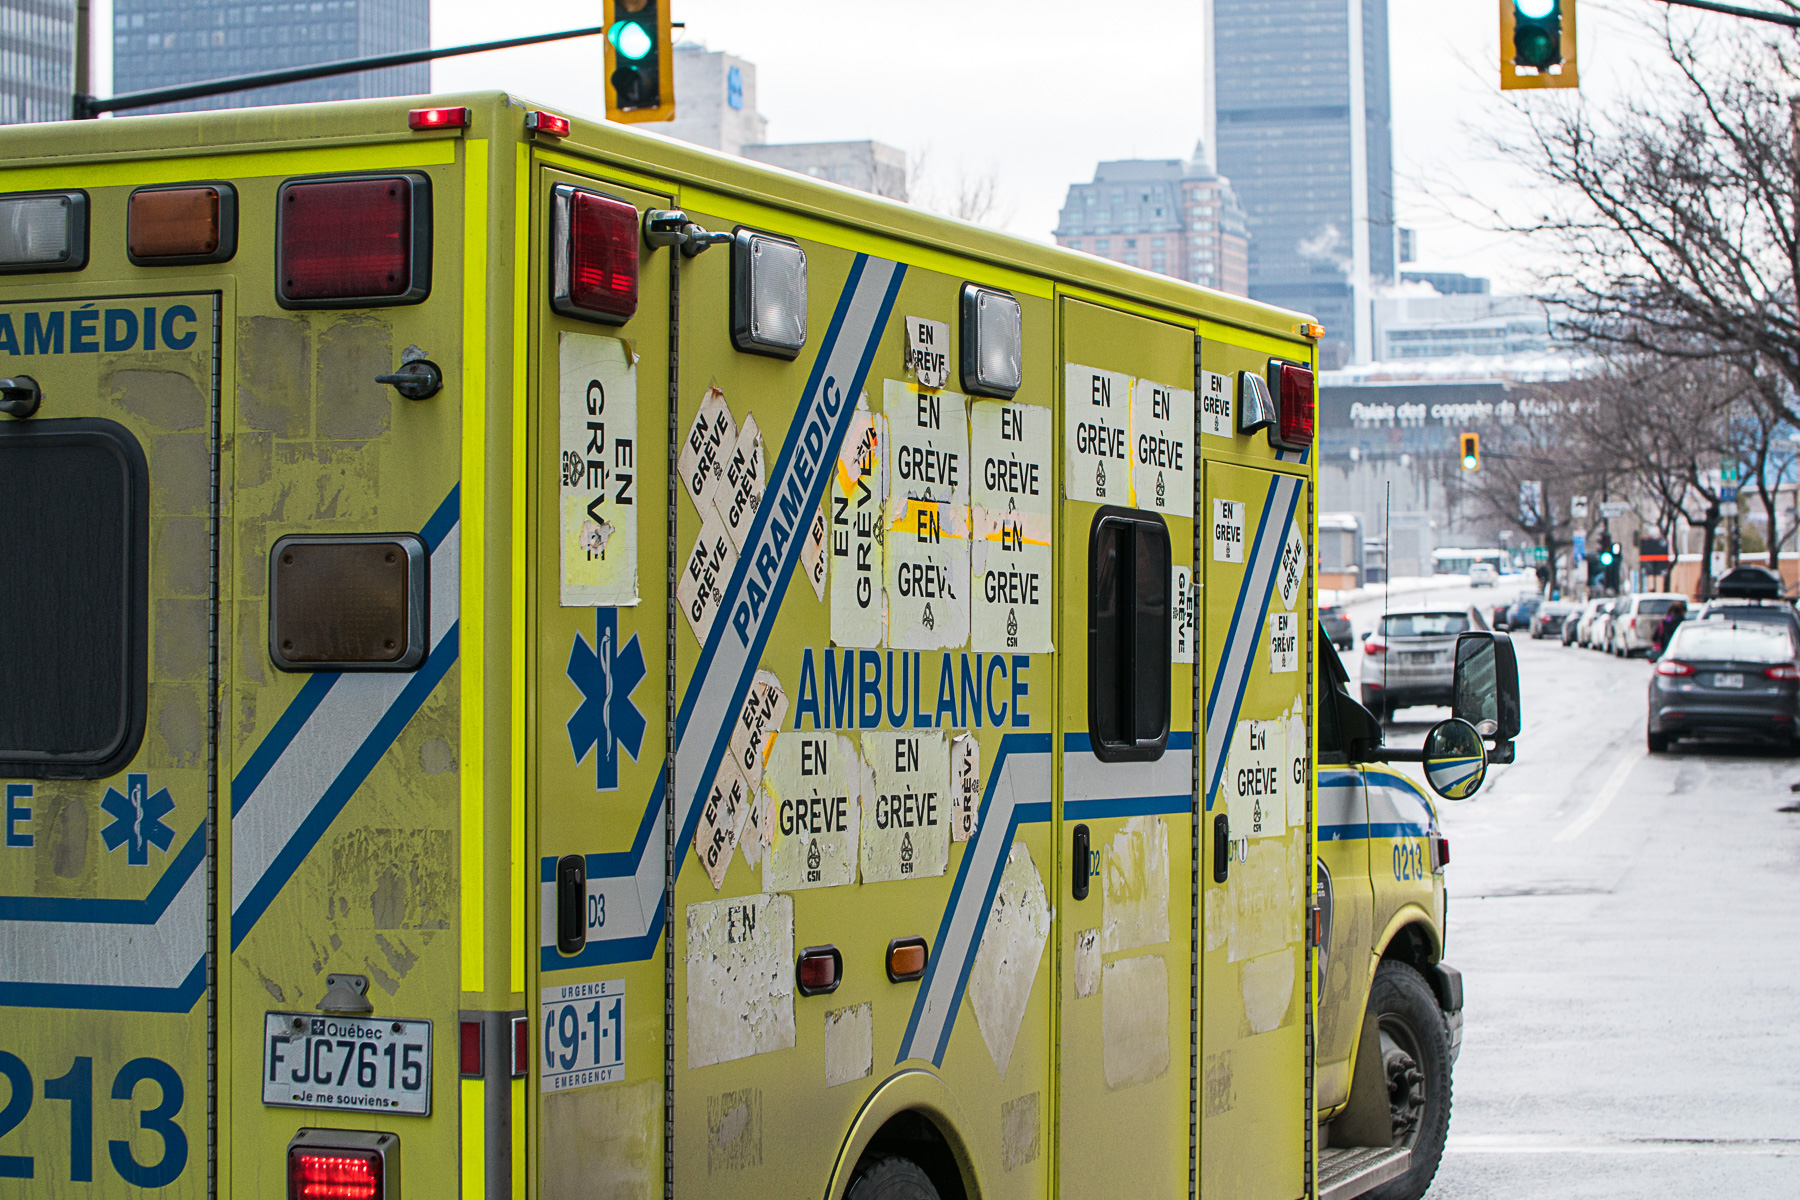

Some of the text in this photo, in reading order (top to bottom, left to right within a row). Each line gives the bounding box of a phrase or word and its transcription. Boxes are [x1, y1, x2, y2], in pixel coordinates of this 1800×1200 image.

[918, 323, 934, 345] EN
[1092, 374, 1111, 408] EN
[1211, 374, 1222, 393] EN
[917, 393, 940, 430] EN
[1153, 388, 1170, 421] EN
[1203, 394, 1230, 418] GRÈVE
[1350, 401, 1395, 421] Palais
[690, 413, 709, 456] EN
[1001, 407, 1023, 442] EN
[1076, 417, 1125, 460] GRÈVE
[692, 409, 728, 496] GRÈVE
[727, 447, 745, 489] EN
[898, 440, 958, 487] GRÈVE
[1138, 430, 1183, 472] GRÈVE
[615, 438, 633, 506] EN
[984, 452, 1039, 496] GRÈVE
[1095, 487, 1106, 498] CSN
[1155, 497, 1165, 507] CSN
[1223, 502, 1234, 519] EN
[732, 375, 841, 650] PARAMÉDIC
[834, 496, 849, 557] EN
[853, 449, 872, 609] GRÈVE
[917, 509, 940, 544] EN
[1002, 519, 1023, 552] EN
[1215, 521, 1241, 543] GRÈVE
[689, 539, 708, 583] EN
[1283, 542, 1292, 571] EN
[1283, 539, 1301, 600] GRÈVE
[691, 535, 728, 623] GRÈVE
[898, 556, 957, 600] GRÈV
[984, 563, 1039, 605] GRÈVE
[1178, 572, 1187, 654] GRÈVE
[1186, 596, 1193, 628] EN
[1278, 615, 1288, 631] EN
[1006, 636, 1018, 647] CSN
[794, 647, 1031, 730] AMBULANCE
[742, 689, 761, 731] EN
[801, 739, 827, 776] EN
[895, 738, 919, 773] EN
[1237, 761, 1277, 798] GRÈVE
[705, 785, 723, 828] EN
[779, 788, 848, 836] GRÈVE
[876, 784, 937, 830] GRÈVE
[1253, 823, 1262, 833] CSN
[807, 870, 821, 883] CSN
[901, 862, 913, 874] CSN
[1090, 850, 1100, 876] D2
[1392, 843, 1423, 881] 0213
[588, 893, 606, 929] D3
[561, 982, 606, 999] URGENCE
[327, 1023, 383, 1040] Québec
[558, 998, 622, 1071] 9-1-1
[269, 1035, 423, 1090] FJC7615
[555, 1068, 612, 1089] EMERGENCY
[300, 1090, 389, 1107] Je me souviens
